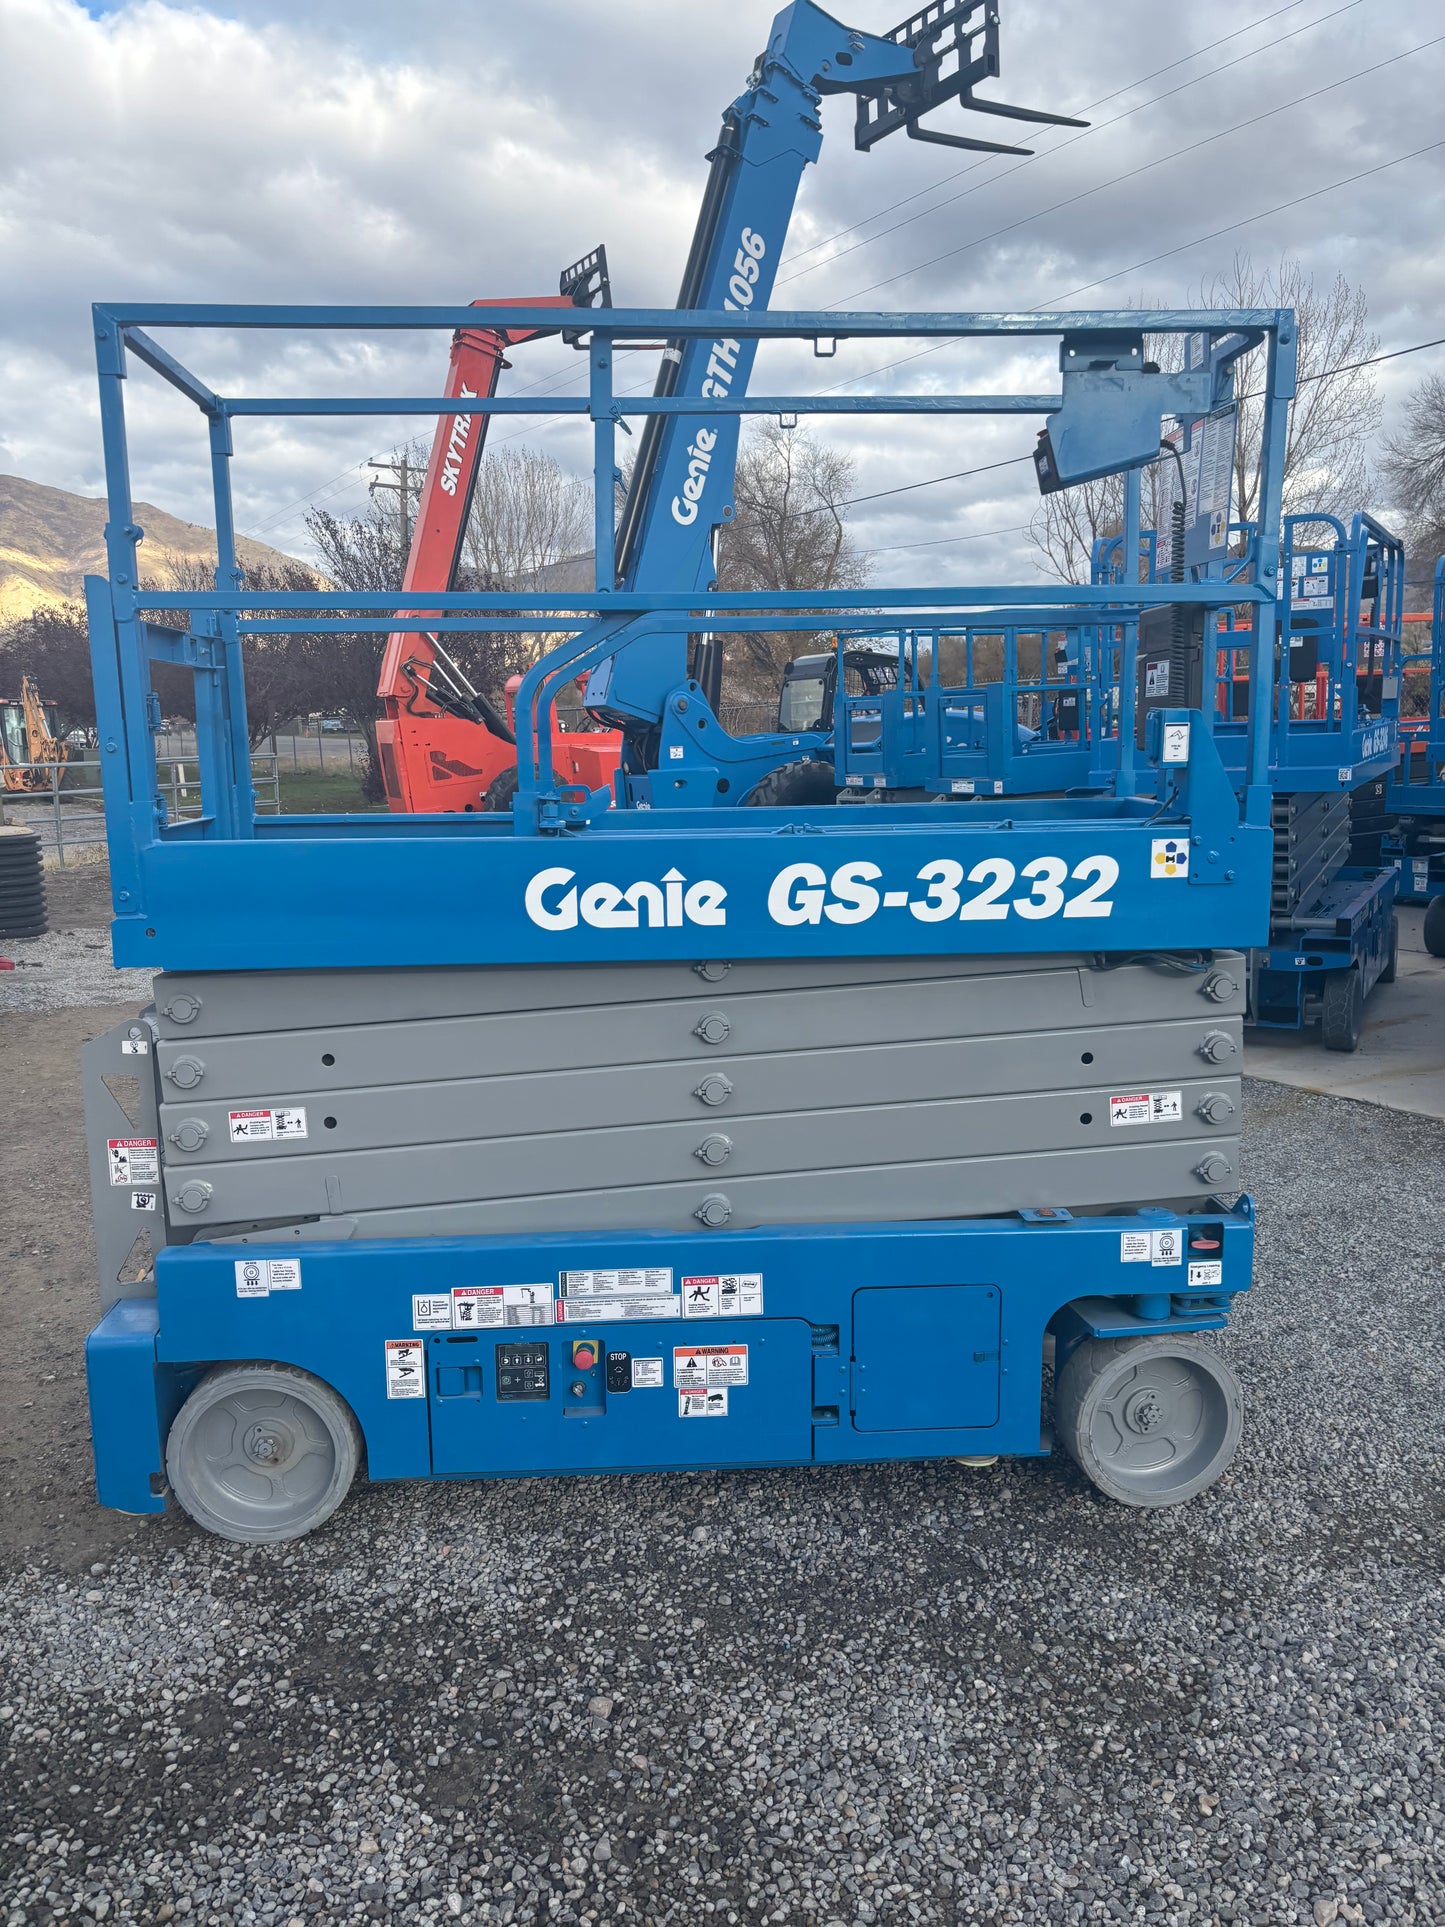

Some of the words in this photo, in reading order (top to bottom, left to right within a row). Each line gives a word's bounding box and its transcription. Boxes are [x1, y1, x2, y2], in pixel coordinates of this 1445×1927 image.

[440, 380, 478, 496] SKYTRK
[671, 428, 717, 526] Genie
[524, 866, 727, 931] Genie
[767, 855, 1120, 925] GS-3232
[467, 1288, 495, 1296] DANGER
[610, 1353, 627, 1361] STOP
